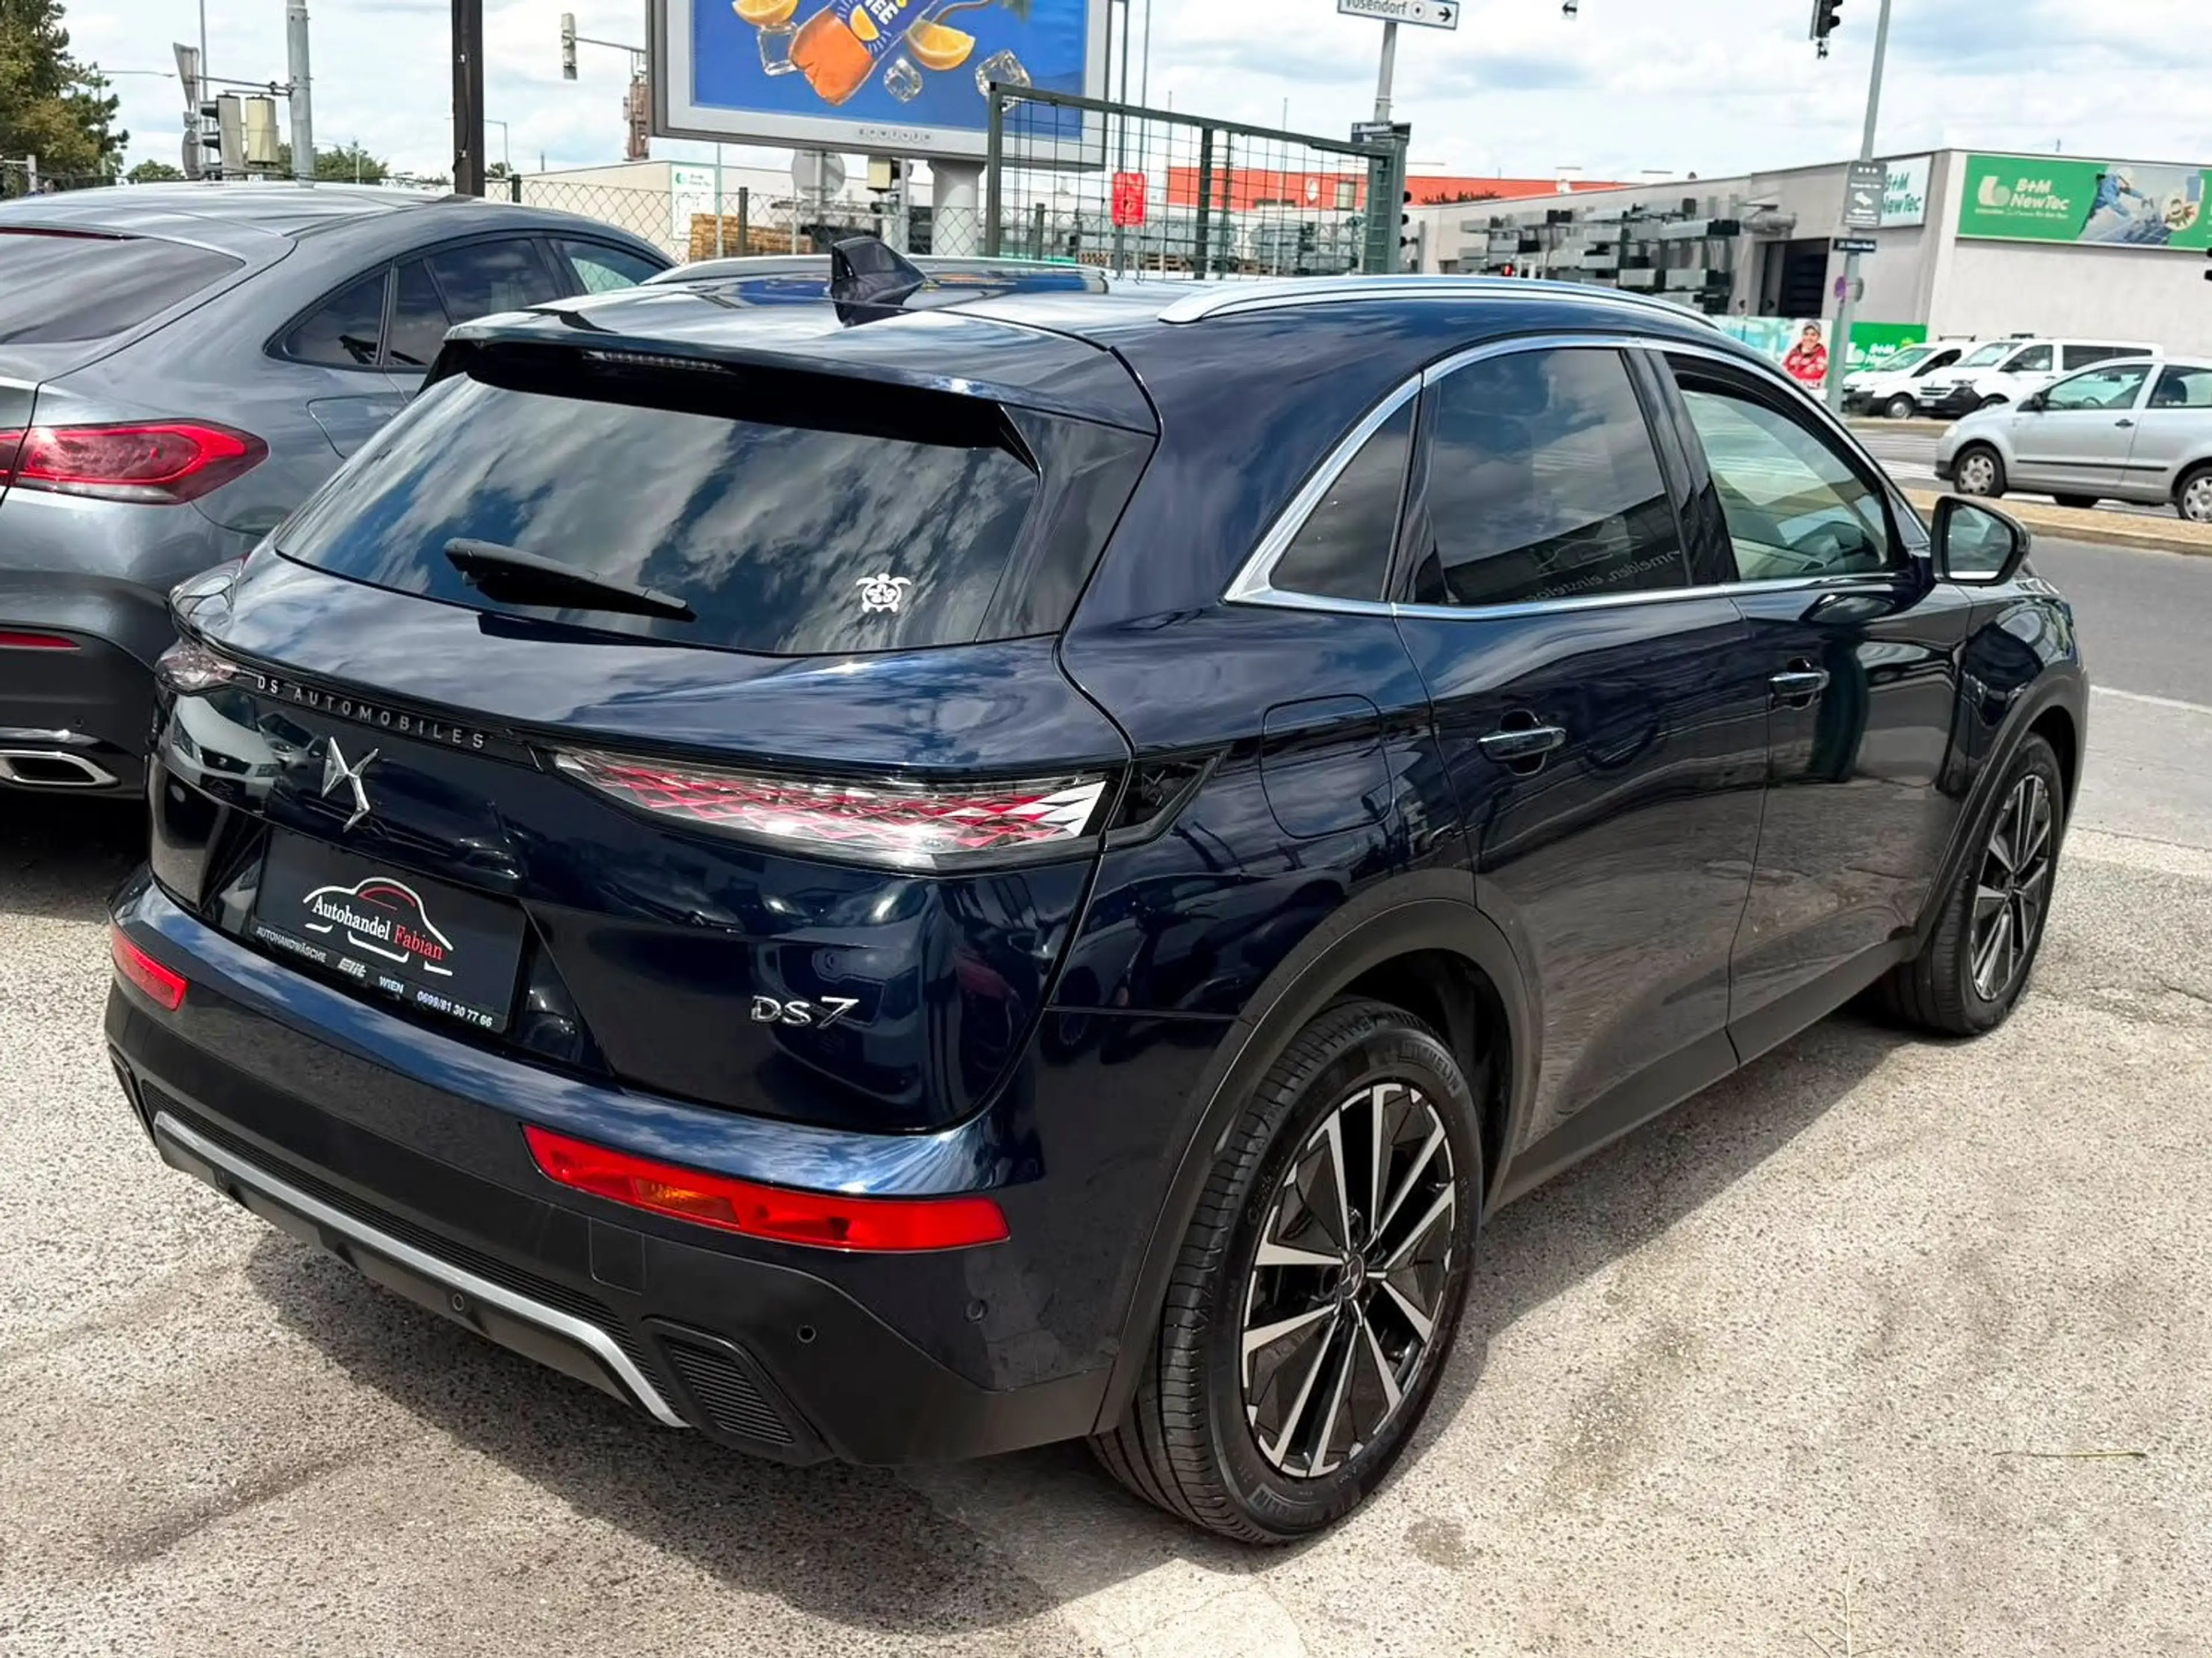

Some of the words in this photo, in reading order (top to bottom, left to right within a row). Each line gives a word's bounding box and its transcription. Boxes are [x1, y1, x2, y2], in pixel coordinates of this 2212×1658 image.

[2010, 193, 2070, 210] NewTec
[2016, 177, 2052, 194] B+M
[257, 675, 279, 694] DS
[293, 687, 483, 749] AUTOMOBILES
[312, 895, 391, 940] Autohandel
[393, 924, 443, 961] Fabian
[379, 976, 404, 994] WIEN
[417, 991, 452, 1012] 0699/81
[453, 1004, 465, 1018] 30
[467, 1008, 480, 1023] 77
[480, 1015, 493, 1028] 66
